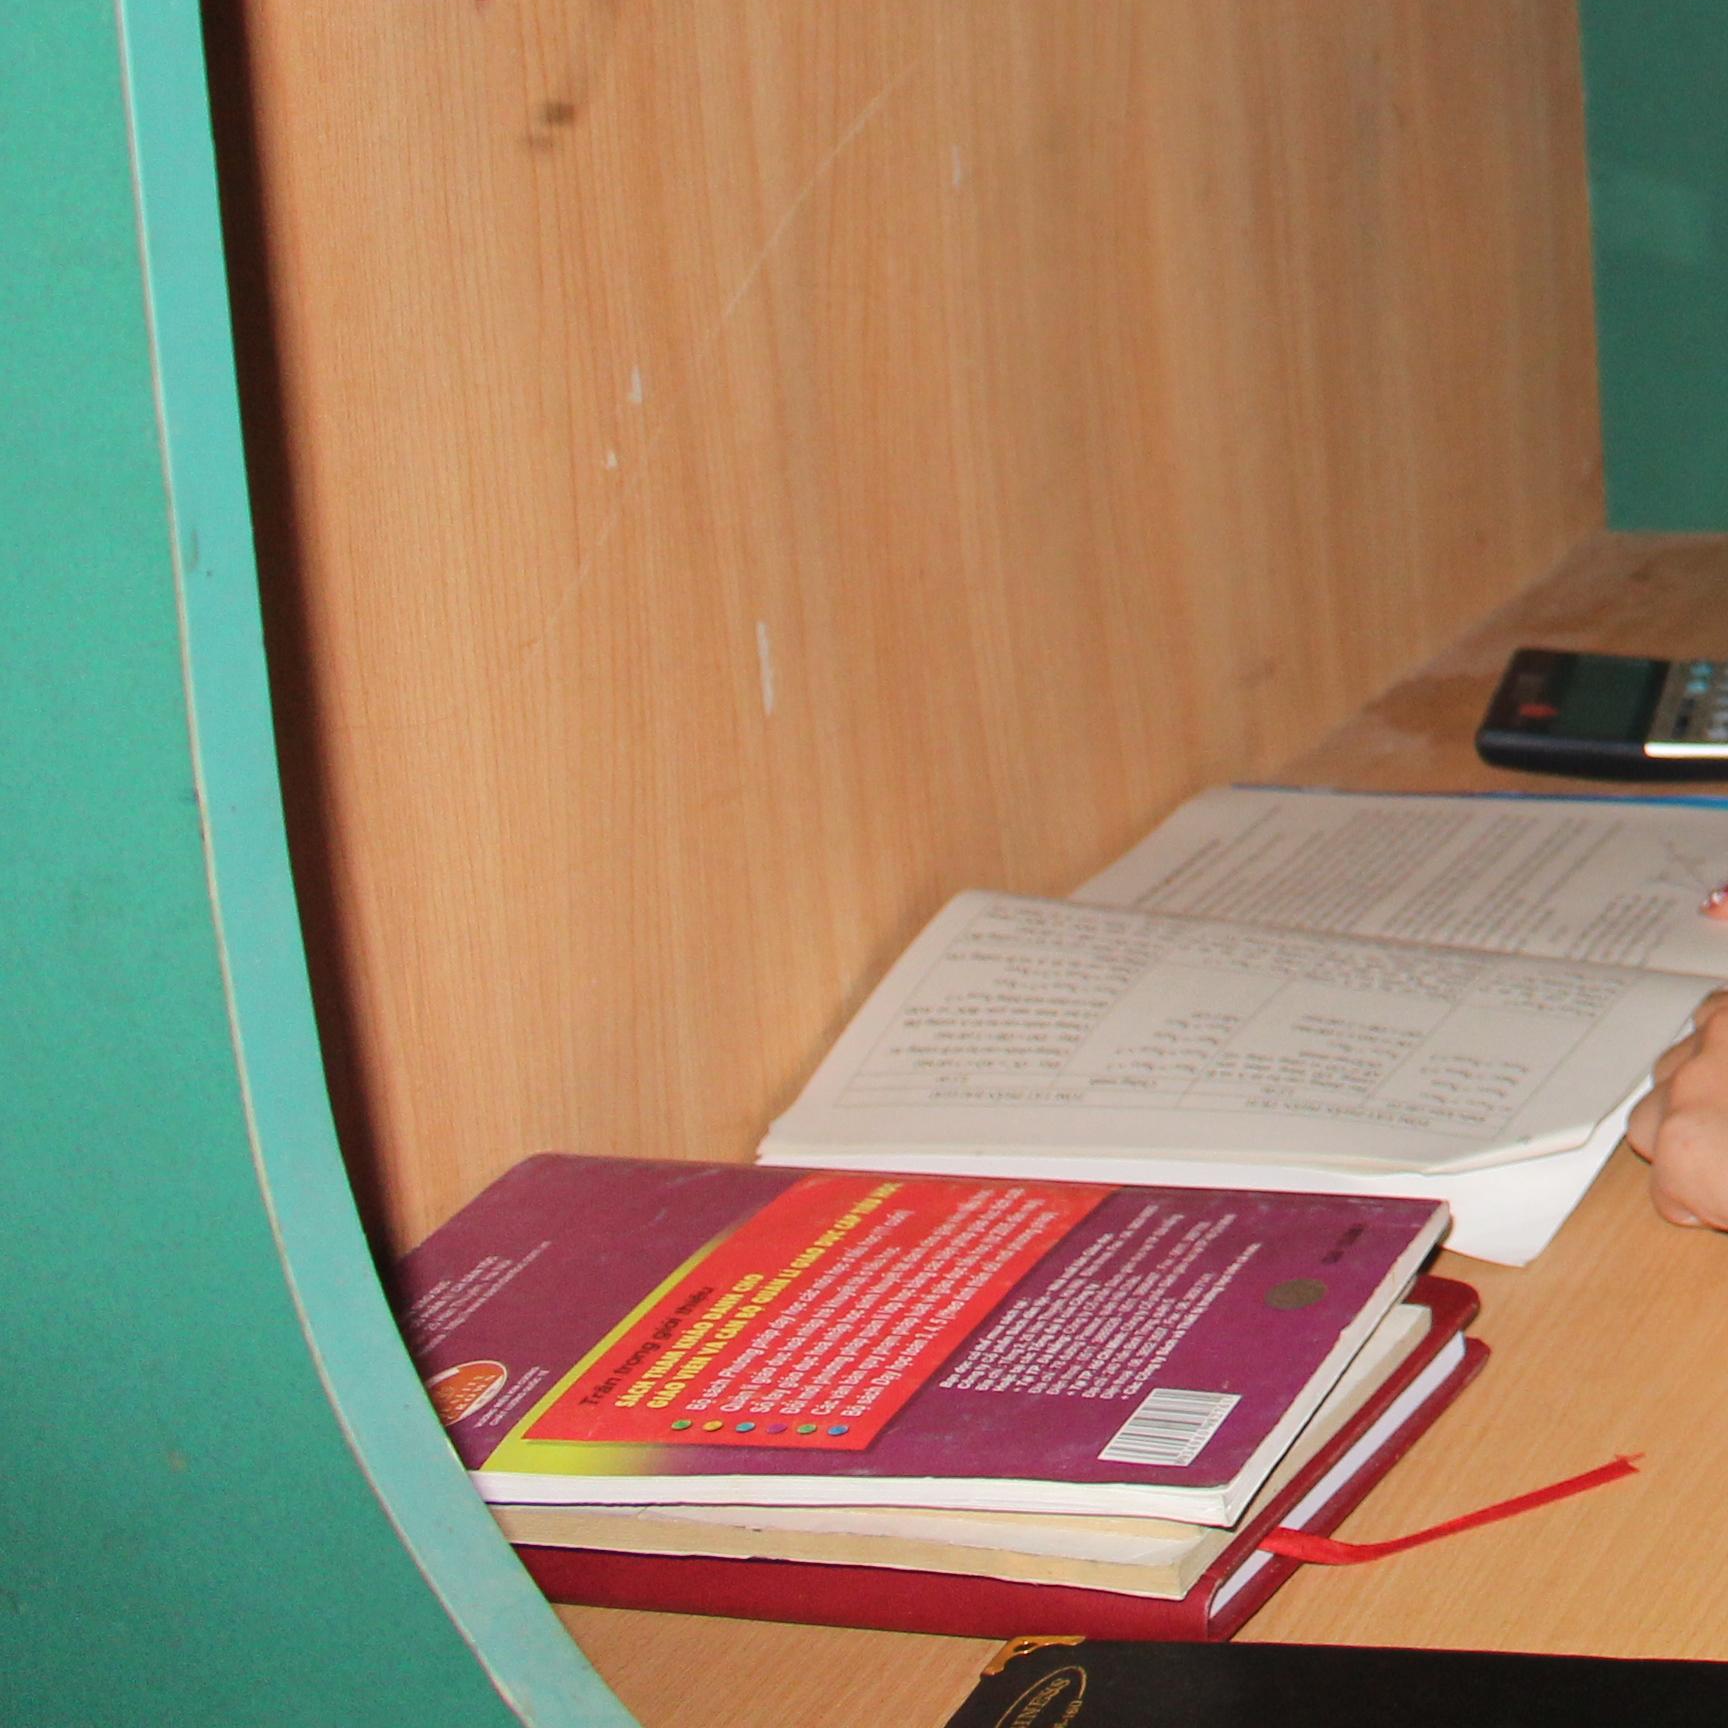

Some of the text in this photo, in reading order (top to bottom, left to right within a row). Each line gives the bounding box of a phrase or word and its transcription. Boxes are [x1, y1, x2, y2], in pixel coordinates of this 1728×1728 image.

[798, 1288, 820, 1302] các
[647, 1381, 685, 1408] GIÁO
[673, 1356, 711, 1379] VIÊN
[697, 1340, 727, 1355] VÀ
[714, 1319, 747, 1339] CÁN
[734, 1304, 763, 1318] BỘ
[751, 1278, 790, 1303] QUẢN
[790, 1246, 825, 1268] GIÁO
[813, 1229, 845, 1246] DỤC
[833, 1213, 861, 1229] CẤP
[780, 1301, 807, 1315] học
[836, 1308, 865, 1323] học
[768, 1315, 796, 1329] dạy
[579, 1287, 712, 1404] Trân trọng giới thiệu
[615, 1273, 763, 1407] SÁCH THAM KHẢO DÀNH CHO
[751, 1328, 780, 1348] pháp
[718, 1347, 764, 1377] Phương
[792, 1355, 819, 1371] dục
[779, 1399, 807, 1414] Đổi
[797, 1384, 822, 1399] mới
[812, 1355, 854, 1385] phương
[839, 1336, 869, 1356] pháp
[839, 1369, 867, 1385] bản
[840, 1338, 928, 1416] Bộ sách Dạy học toán
[956, 1369, 985, 1389] Công
[1134, 1361, 1161, 1381] Công
[702, 1378, 731, 1397] sách
[719, 1390, 754, 1412] Quản
[750, 1366, 777, 1384] giáo
[765, 1351, 792, 1366] dục
[777, 1371, 804, 1388] giáo
[938, 1372, 960, 1388] Bạn
[760, 1388, 791, 1401] tay
[829, 1384, 853, 1399] văn
[685, 1398, 715, 1410] Bộ
[749, 1400, 775, 1413] Sổ
[810, 1399, 839, 1415] Các
